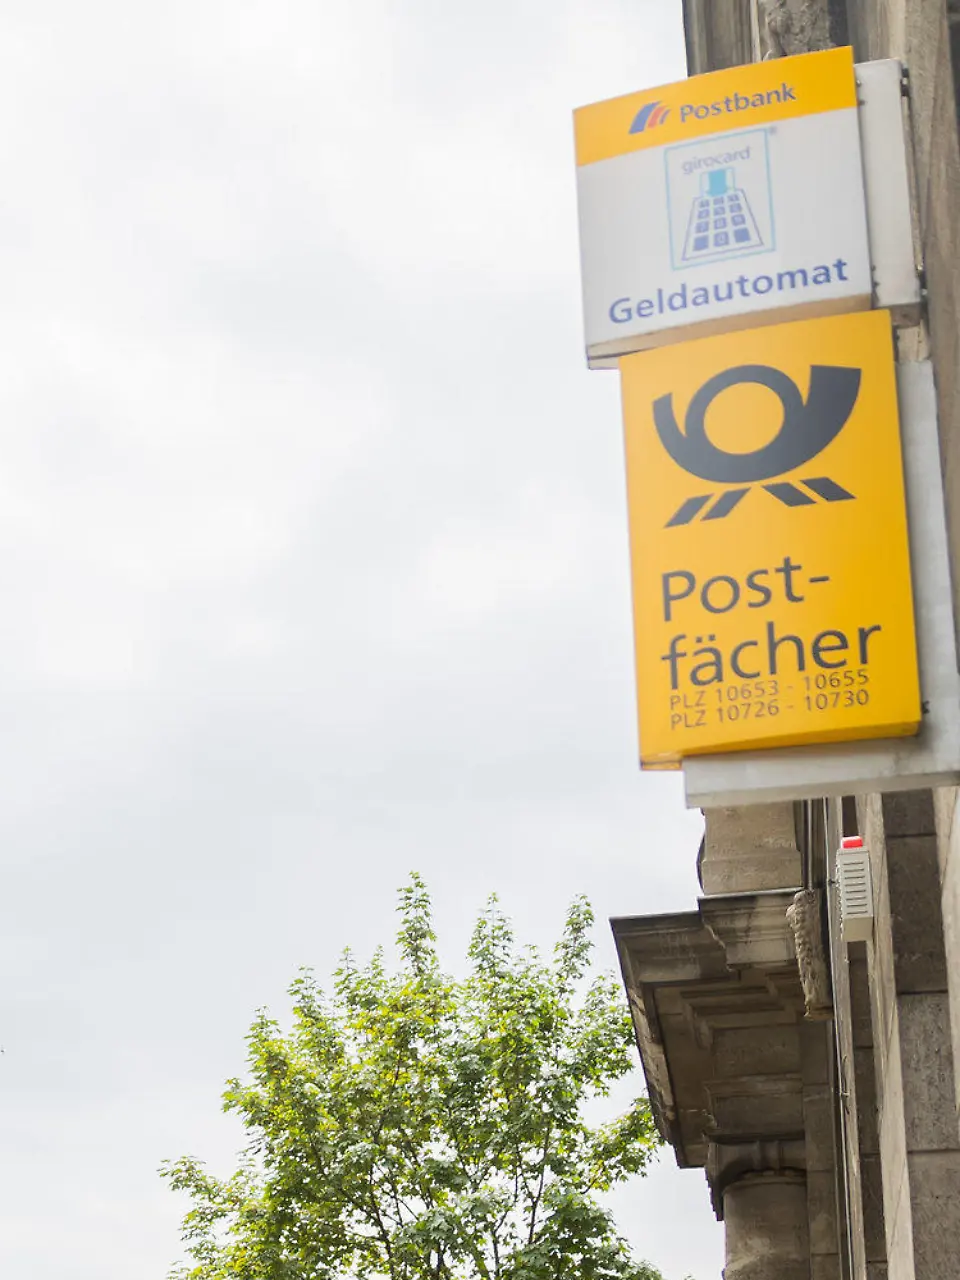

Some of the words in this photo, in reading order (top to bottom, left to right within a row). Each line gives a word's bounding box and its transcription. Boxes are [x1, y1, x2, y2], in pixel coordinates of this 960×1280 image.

[680, 84, 797, 123] Postbank
[681, 146, 751, 175] girocard
[609, 258, 849, 325] Geldautomat
[661, 556, 830, 622] Post-
[661, 621, 882, 690] fächer
[669, 690, 707, 710] PLZ
[715, 680, 779, 703] 10653
[803, 669, 870, 691] 10655
[670, 710, 707, 730] PLZ
[717, 700, 780, 723] 10726
[804, 689, 870, 711] 10730
